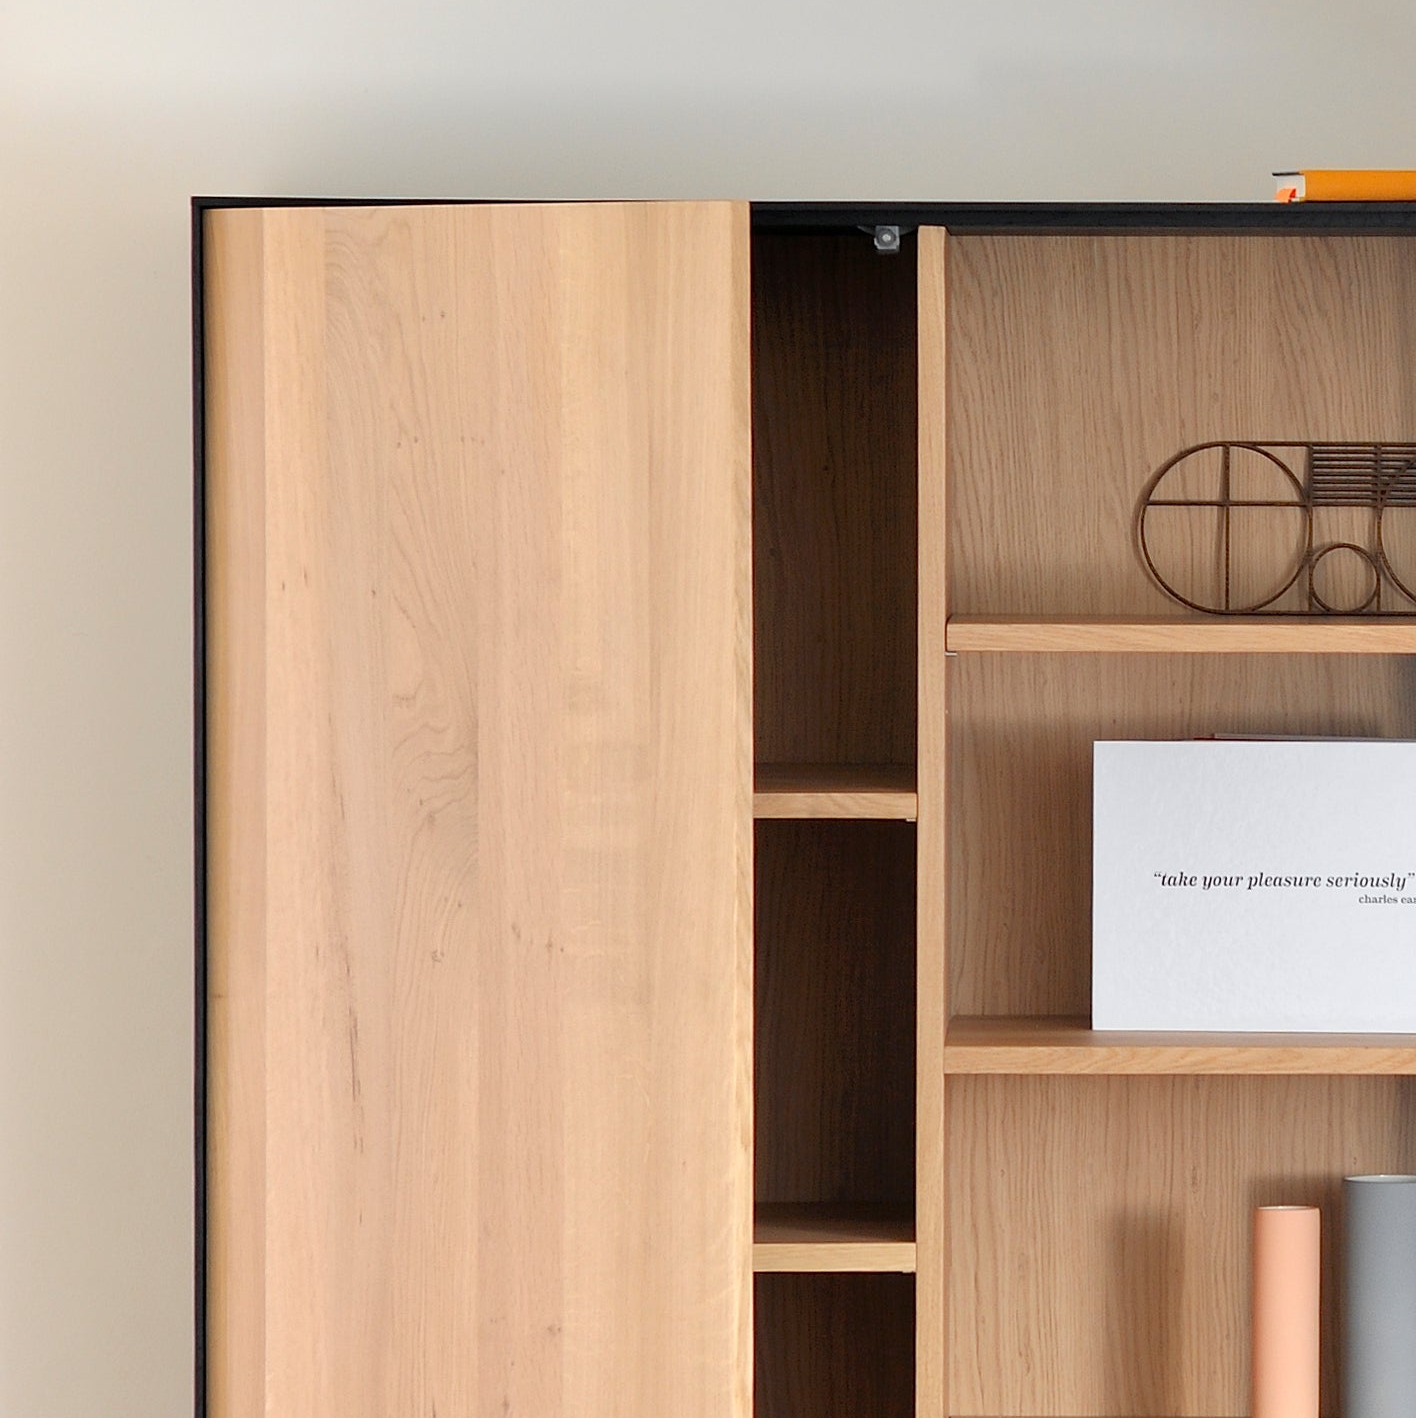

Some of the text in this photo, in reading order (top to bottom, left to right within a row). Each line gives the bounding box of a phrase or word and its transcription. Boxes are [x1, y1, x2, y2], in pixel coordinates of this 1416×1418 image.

[1153, 870, 1416, 891] “take your pleasure seriously”
[1358, 893, 1399, 905] charles
